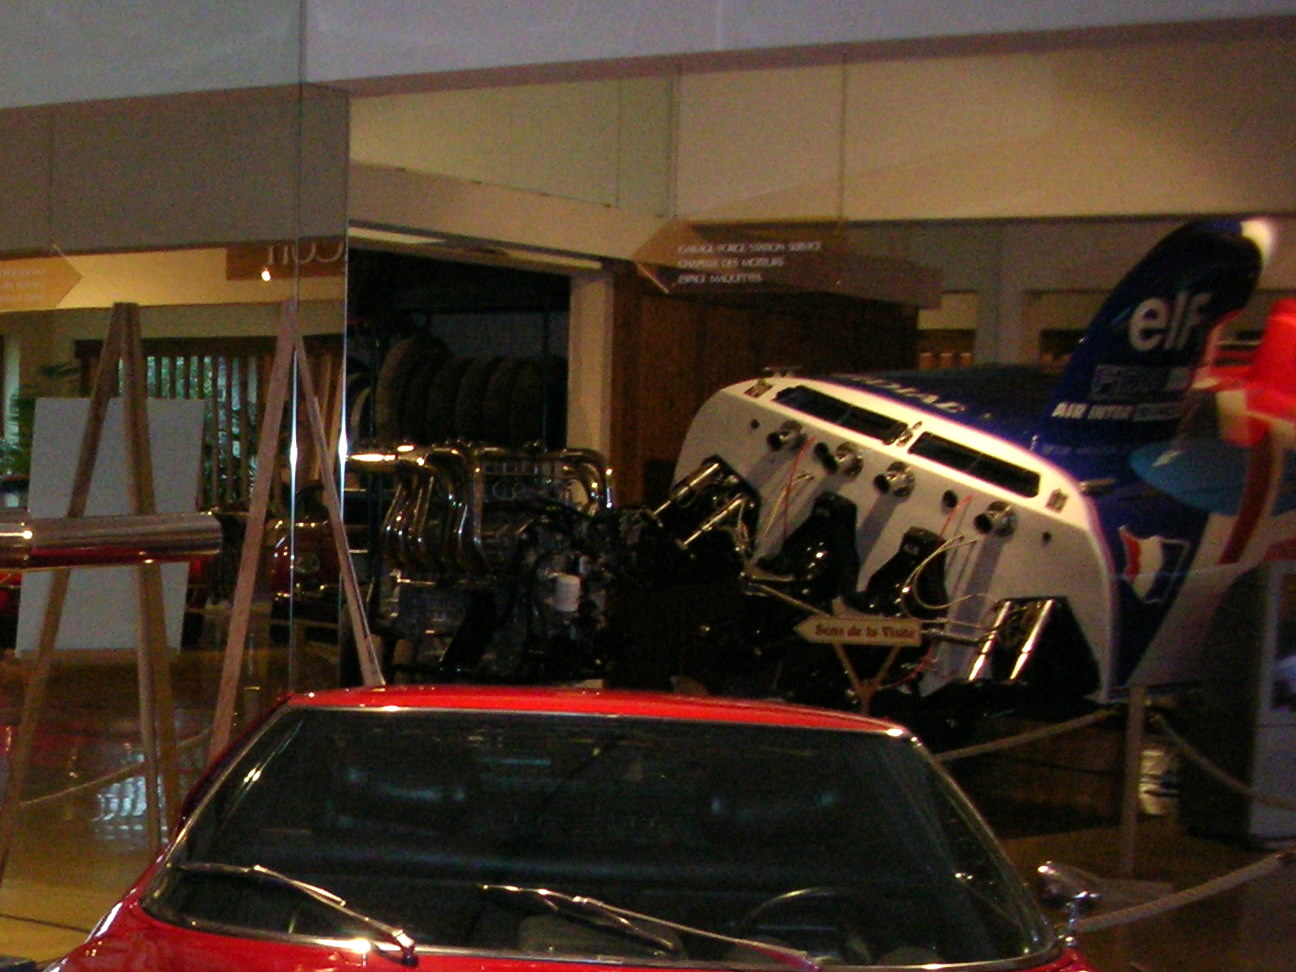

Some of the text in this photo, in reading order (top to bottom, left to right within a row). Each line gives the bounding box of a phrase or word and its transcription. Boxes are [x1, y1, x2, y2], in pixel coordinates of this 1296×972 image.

[1129, 290, 1214, 351] elf
[1051, 401, 1088, 418] AIR
[815, 623, 844, 636] Sens
[847, 626, 861, 637] de
